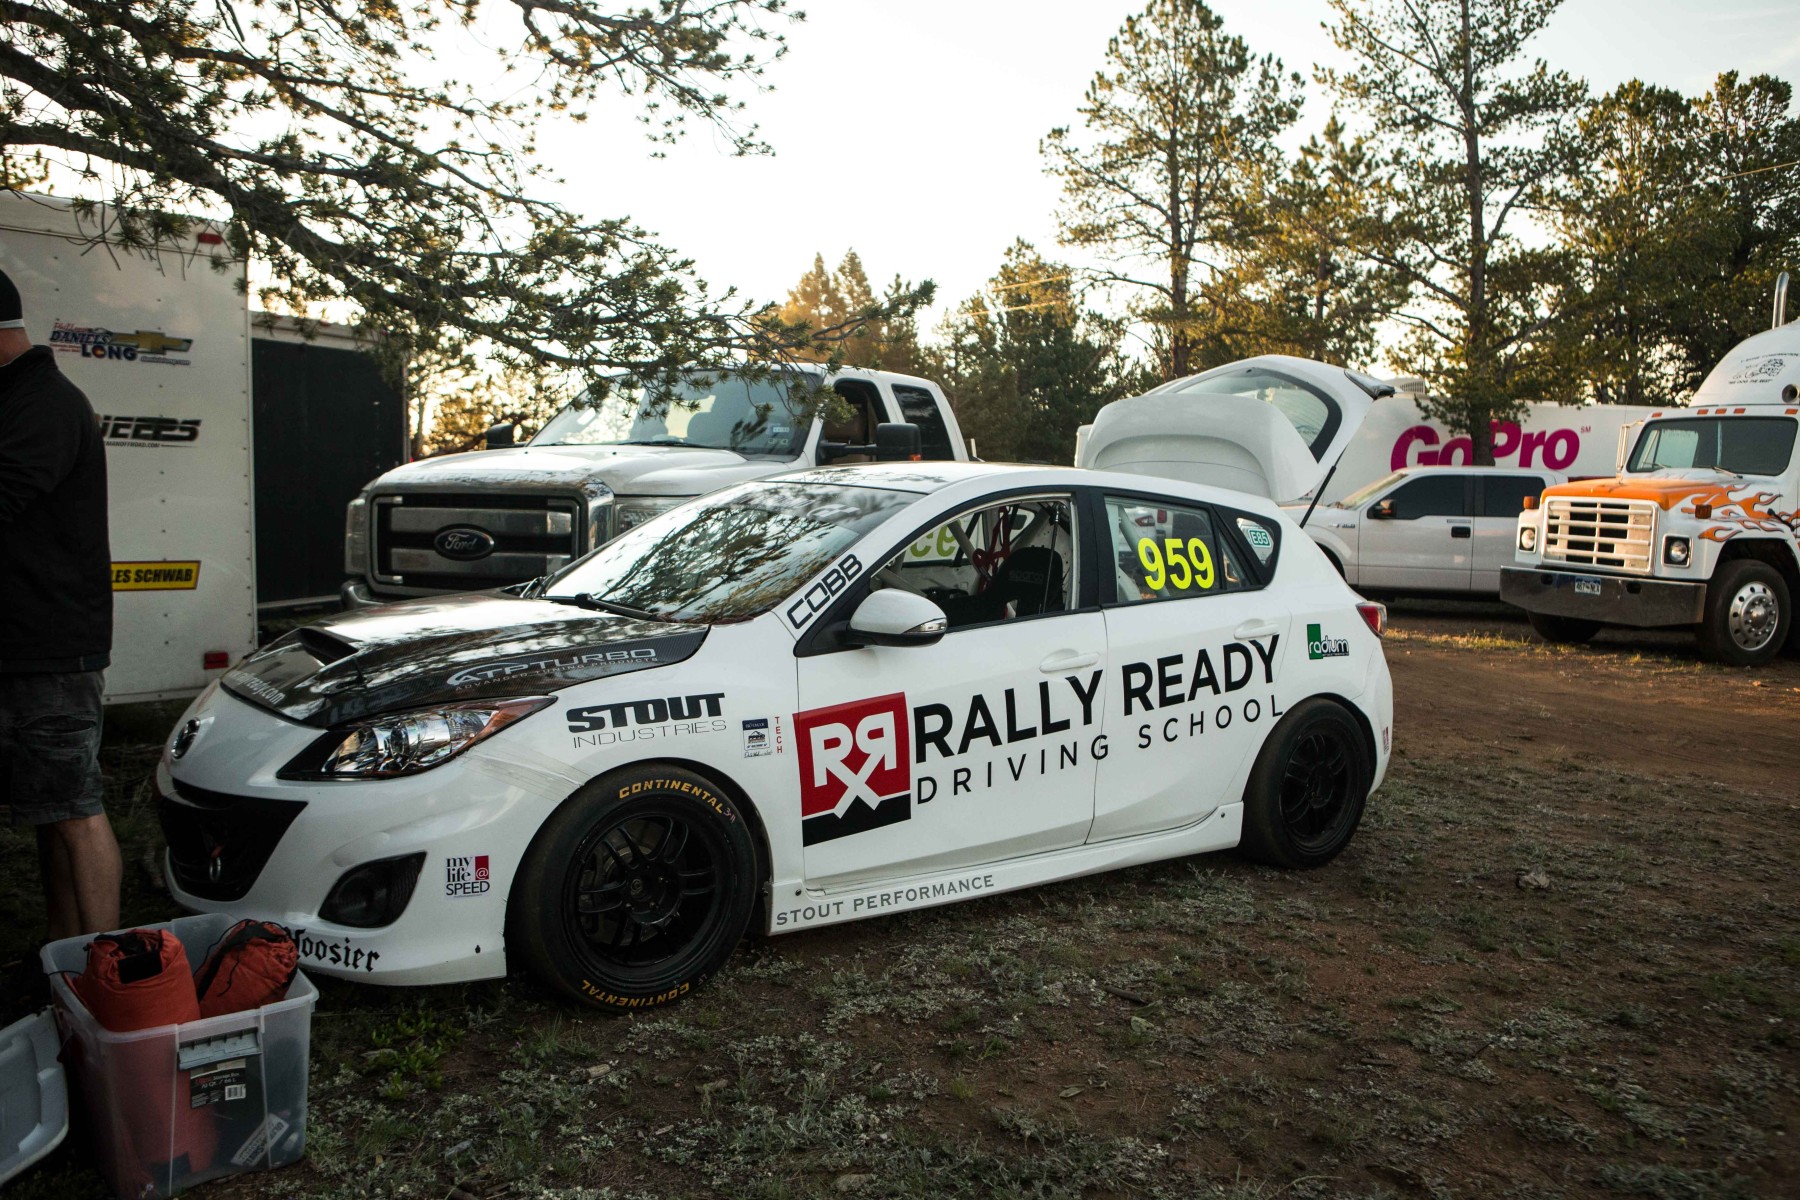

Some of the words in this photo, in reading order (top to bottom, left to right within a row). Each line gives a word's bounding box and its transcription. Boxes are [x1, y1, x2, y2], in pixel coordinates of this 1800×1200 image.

[49, 330, 112, 345] DANIELS
[81, 344, 138, 361] LONG
[1390, 419, 1580, 473] GoPro
[445, 533, 478, 551] Ford
[1250, 531, 1269, 545] E85
[134, 568, 193, 582] SCHWAB
[1137, 537, 1215, 591] 959
[787, 554, 862, 629] COBB
[1309, 634, 1349, 654] radium
[455, 672, 527, 691] ADVANCED
[534, 664, 585, 677] TUNING
[591, 657, 658, 668] PRODUCTS
[566, 692, 726, 733] STOUT
[913, 669, 1103, 763] RALLY
[1121, 634, 1279, 716] READY
[573, 719, 727, 749] INDUSTRIES
[775, 716, 783, 754] TECH
[917, 735, 1108, 804] DRIVING
[1138, 695, 1284, 749] SCHOOL
[619, 779, 724, 814] CONTINENTAL
[446, 856, 473, 870] my
[446, 867, 471, 882] life
[446, 880, 490, 896] SPEED
[776, 901, 844, 926] STOUT
[853, 875, 994, 912] PERFORMANCE
[582, 980, 690, 1007] CONTINENTAL
